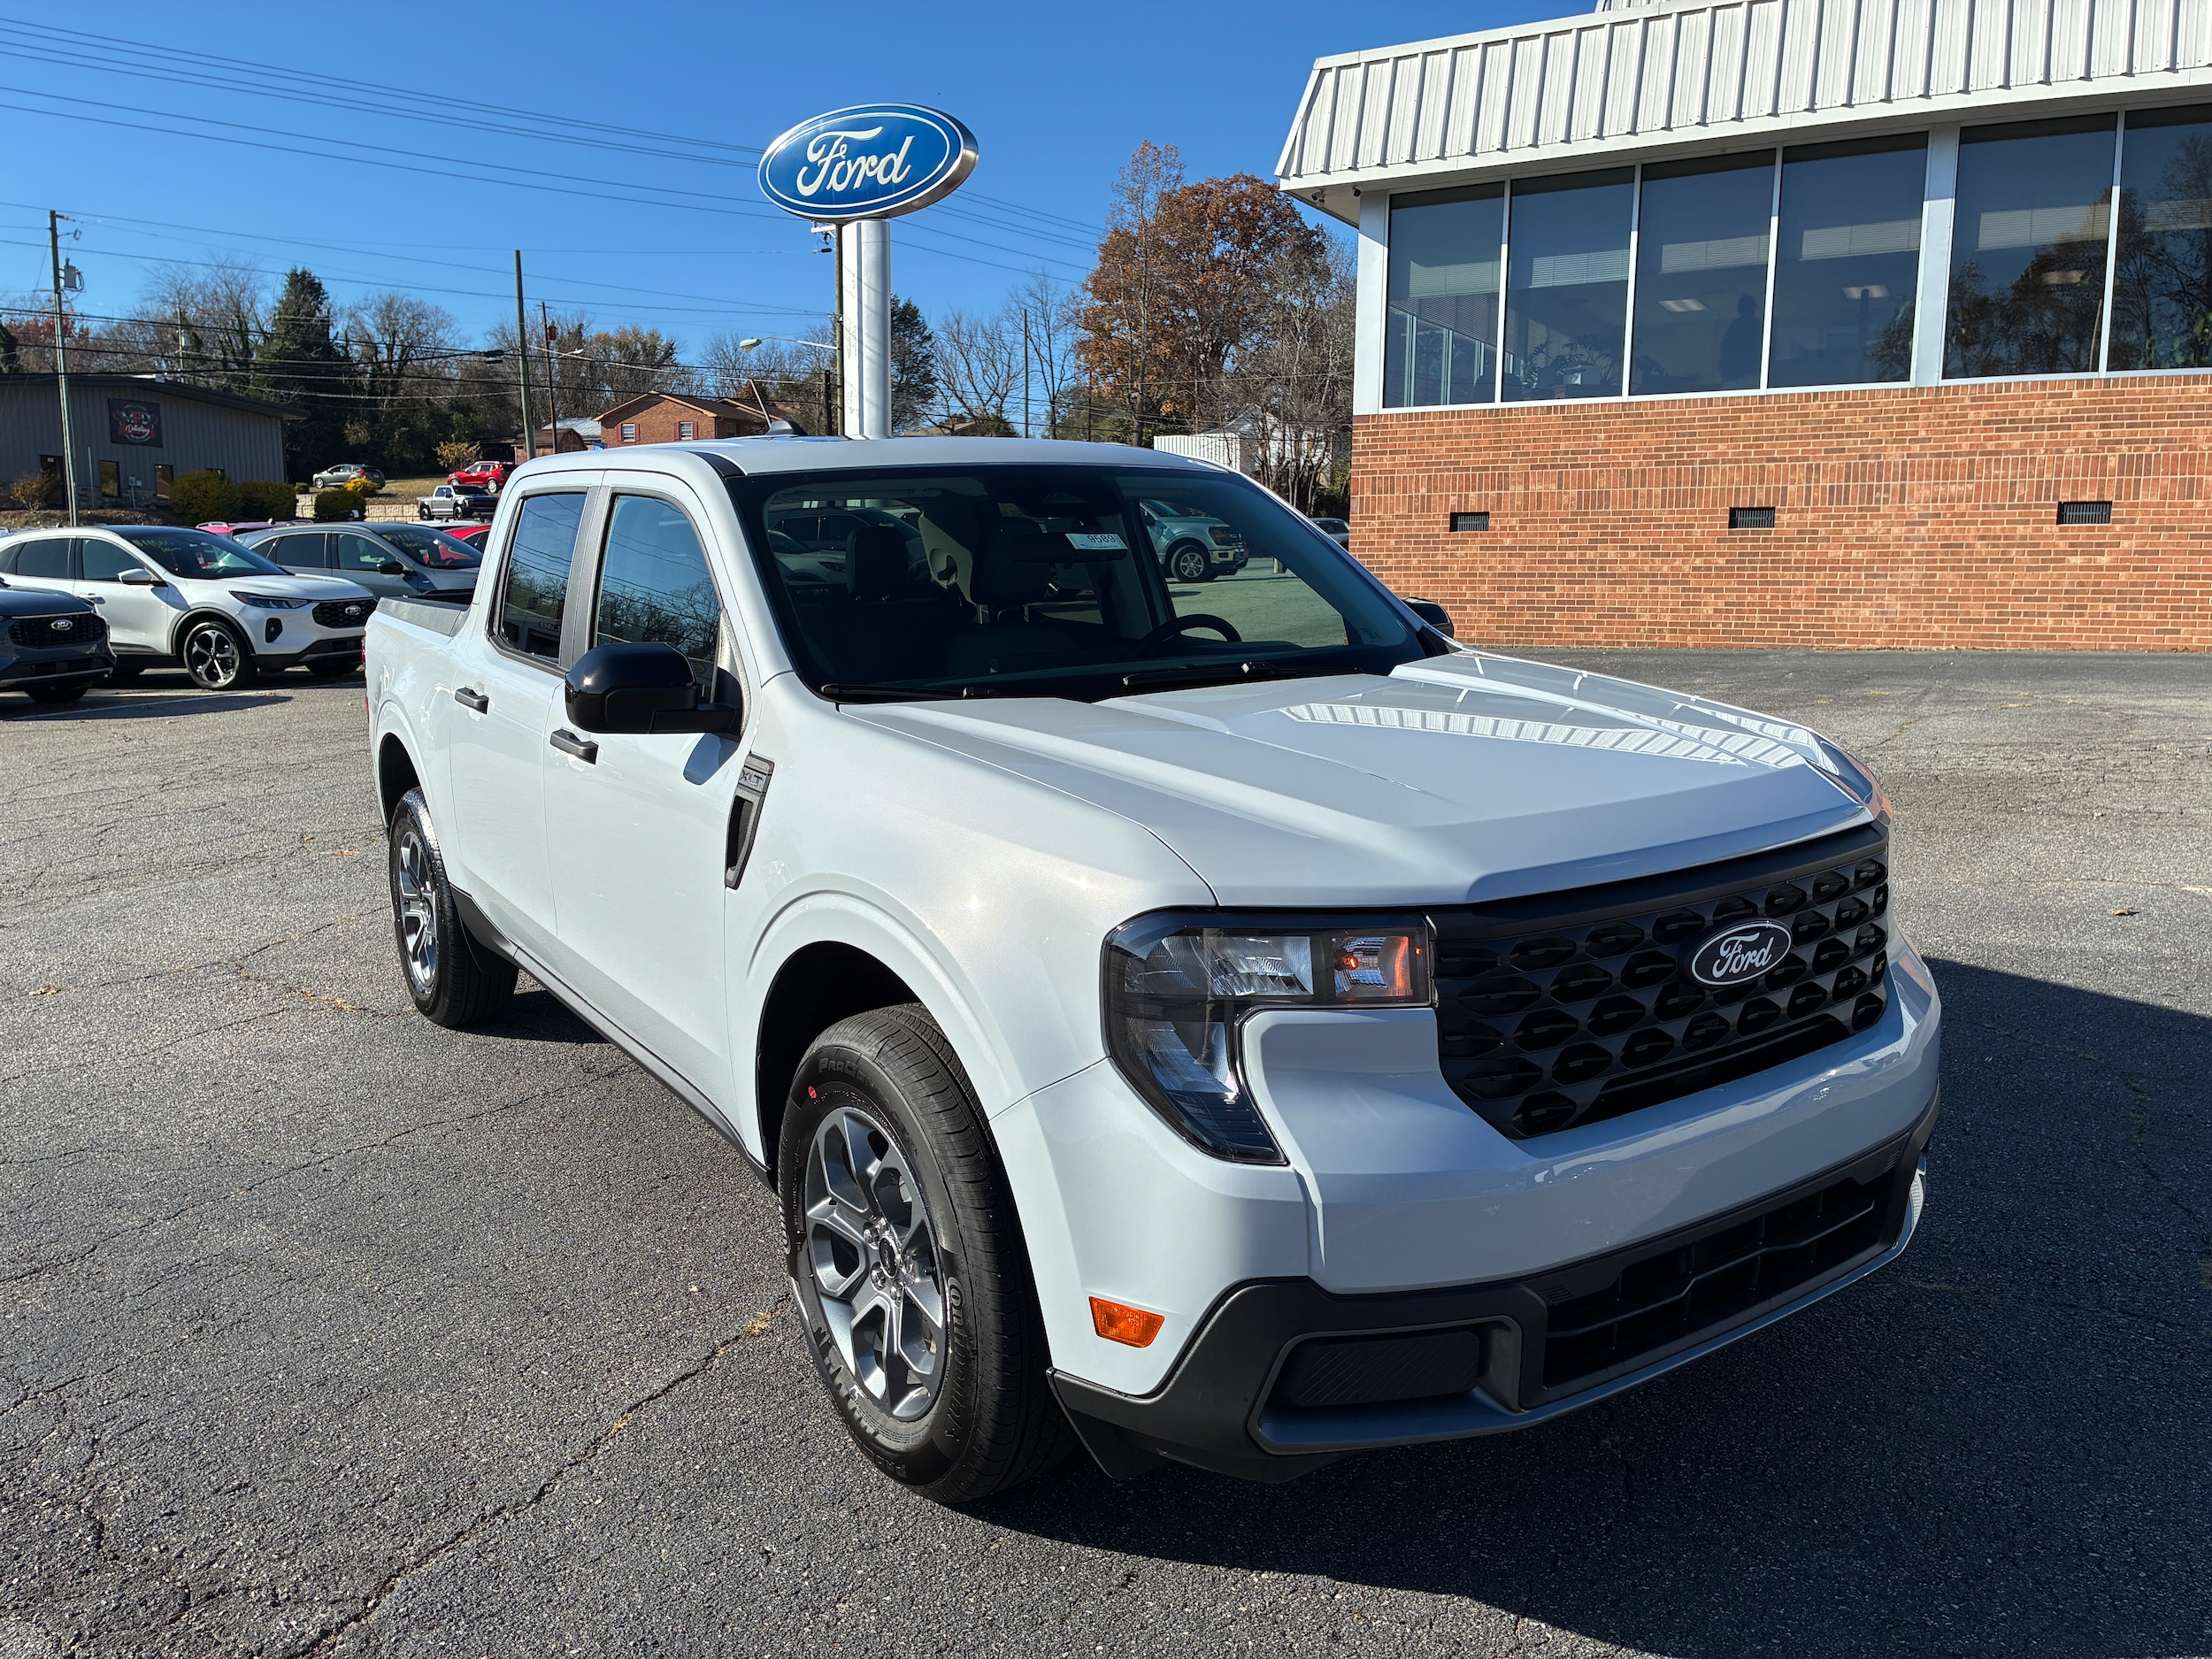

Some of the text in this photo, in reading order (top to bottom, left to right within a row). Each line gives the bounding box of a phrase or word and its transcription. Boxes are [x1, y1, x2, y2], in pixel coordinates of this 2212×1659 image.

[796, 126, 915, 196] Ford
[1087, 534, 1116, 543] 9589
[739, 769, 764, 787] XLT
[1712, 932, 1774, 979] Ford
